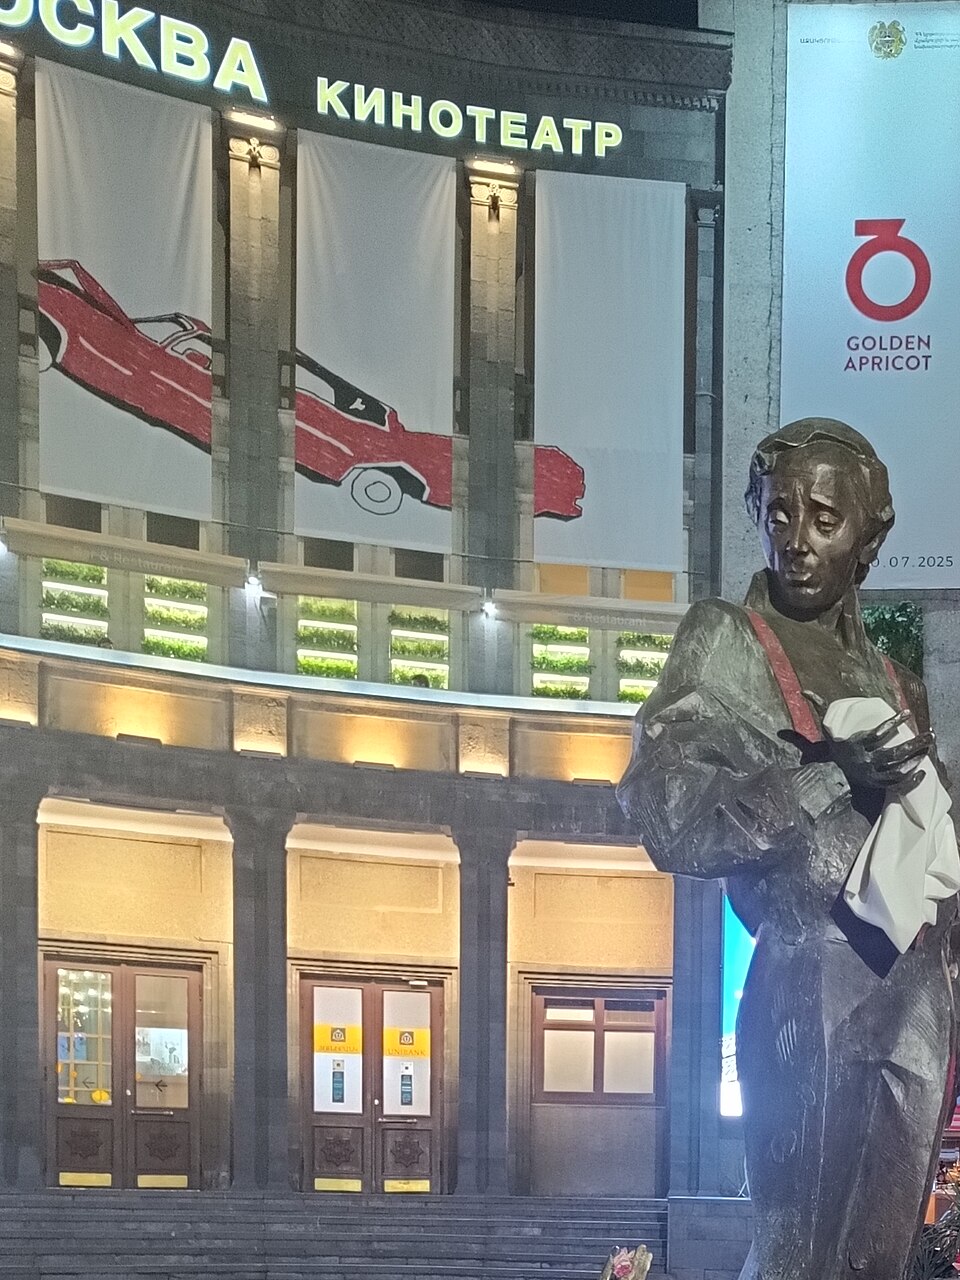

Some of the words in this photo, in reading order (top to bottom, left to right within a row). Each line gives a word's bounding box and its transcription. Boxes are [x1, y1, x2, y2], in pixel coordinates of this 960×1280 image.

[316, 76, 623, 157] КИНОТЕАТР
[846, 334, 931, 351] GOLDEN
[843, 354, 932, 371] APRICOT
[387, 1047, 427, 1056] UNIBANK
